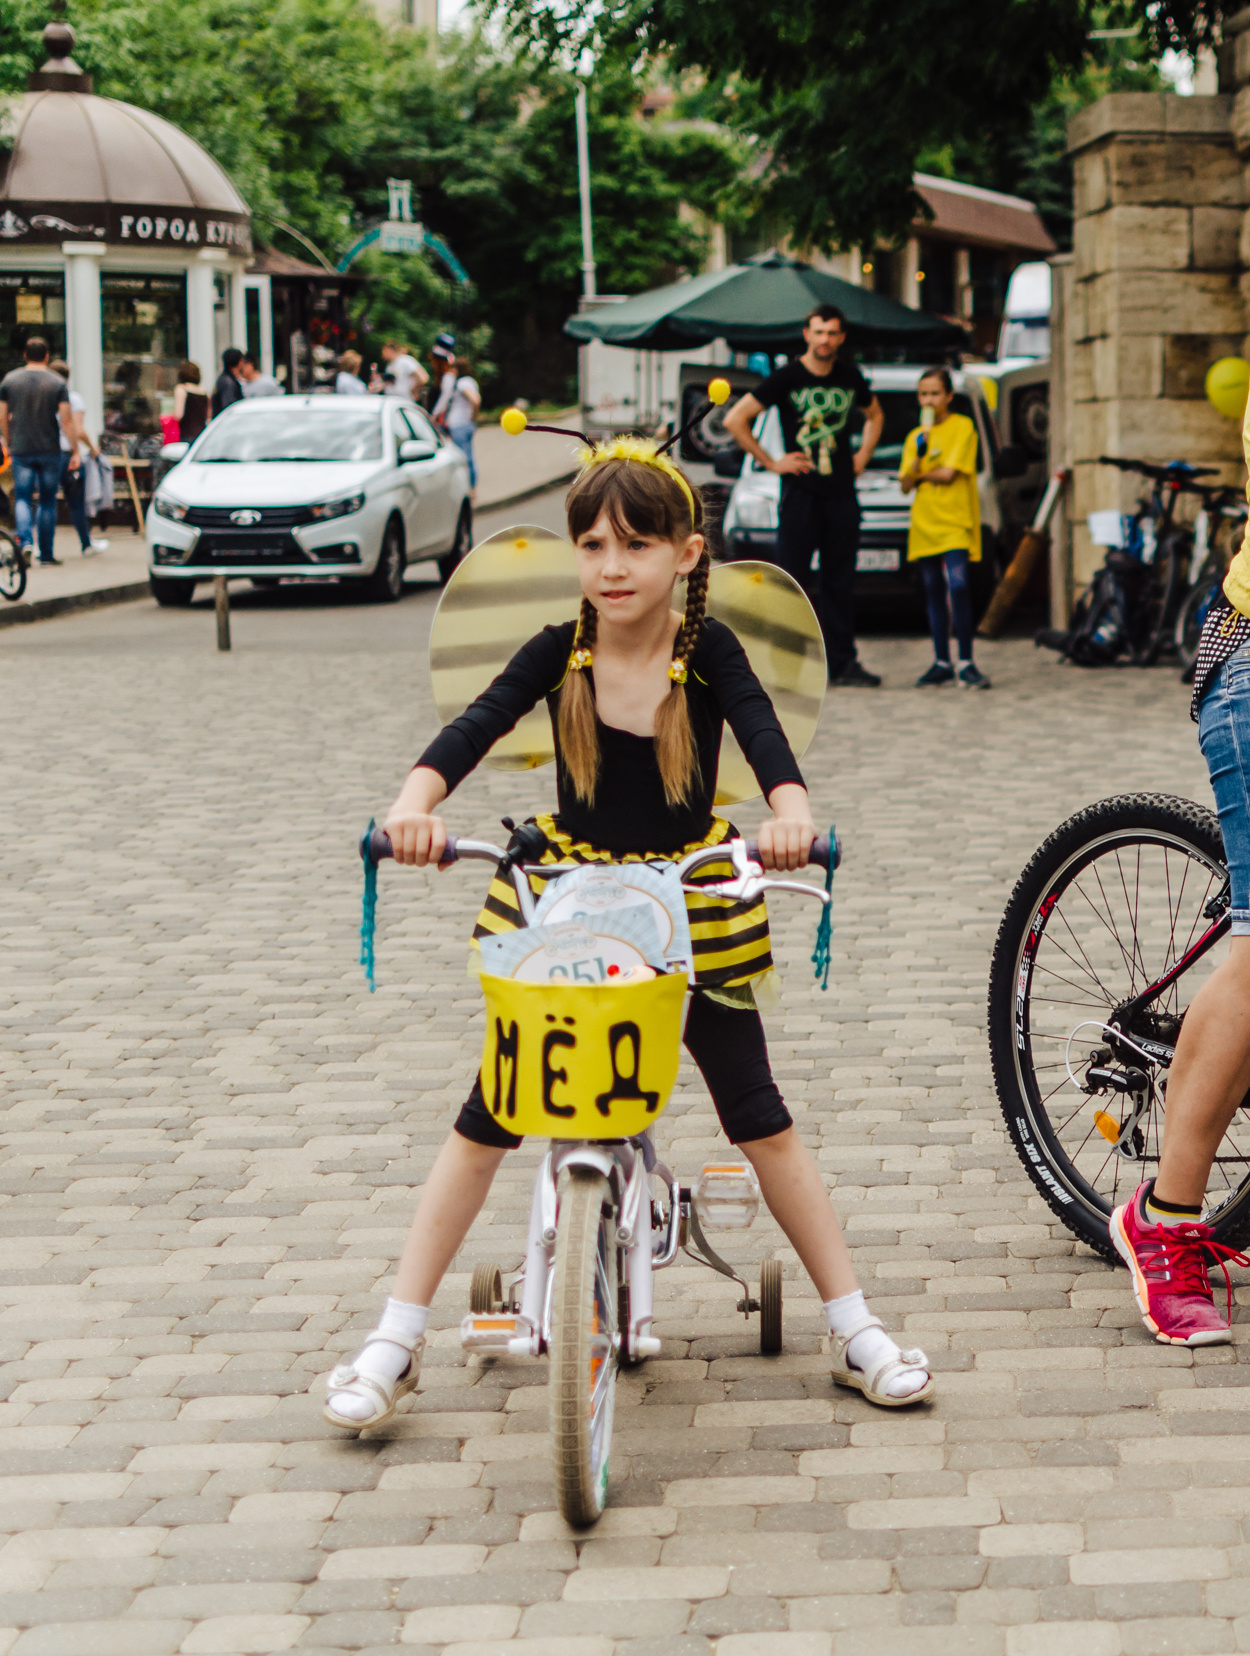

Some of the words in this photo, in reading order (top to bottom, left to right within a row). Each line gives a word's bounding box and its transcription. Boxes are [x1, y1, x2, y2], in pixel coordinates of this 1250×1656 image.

[120, 215, 199, 243] ГОРОД
[1141, 1042, 1165, 1056] Ladies
[493, 1014, 660, 1119] МЁД
[1023, 1142, 1042, 1163] SIX
